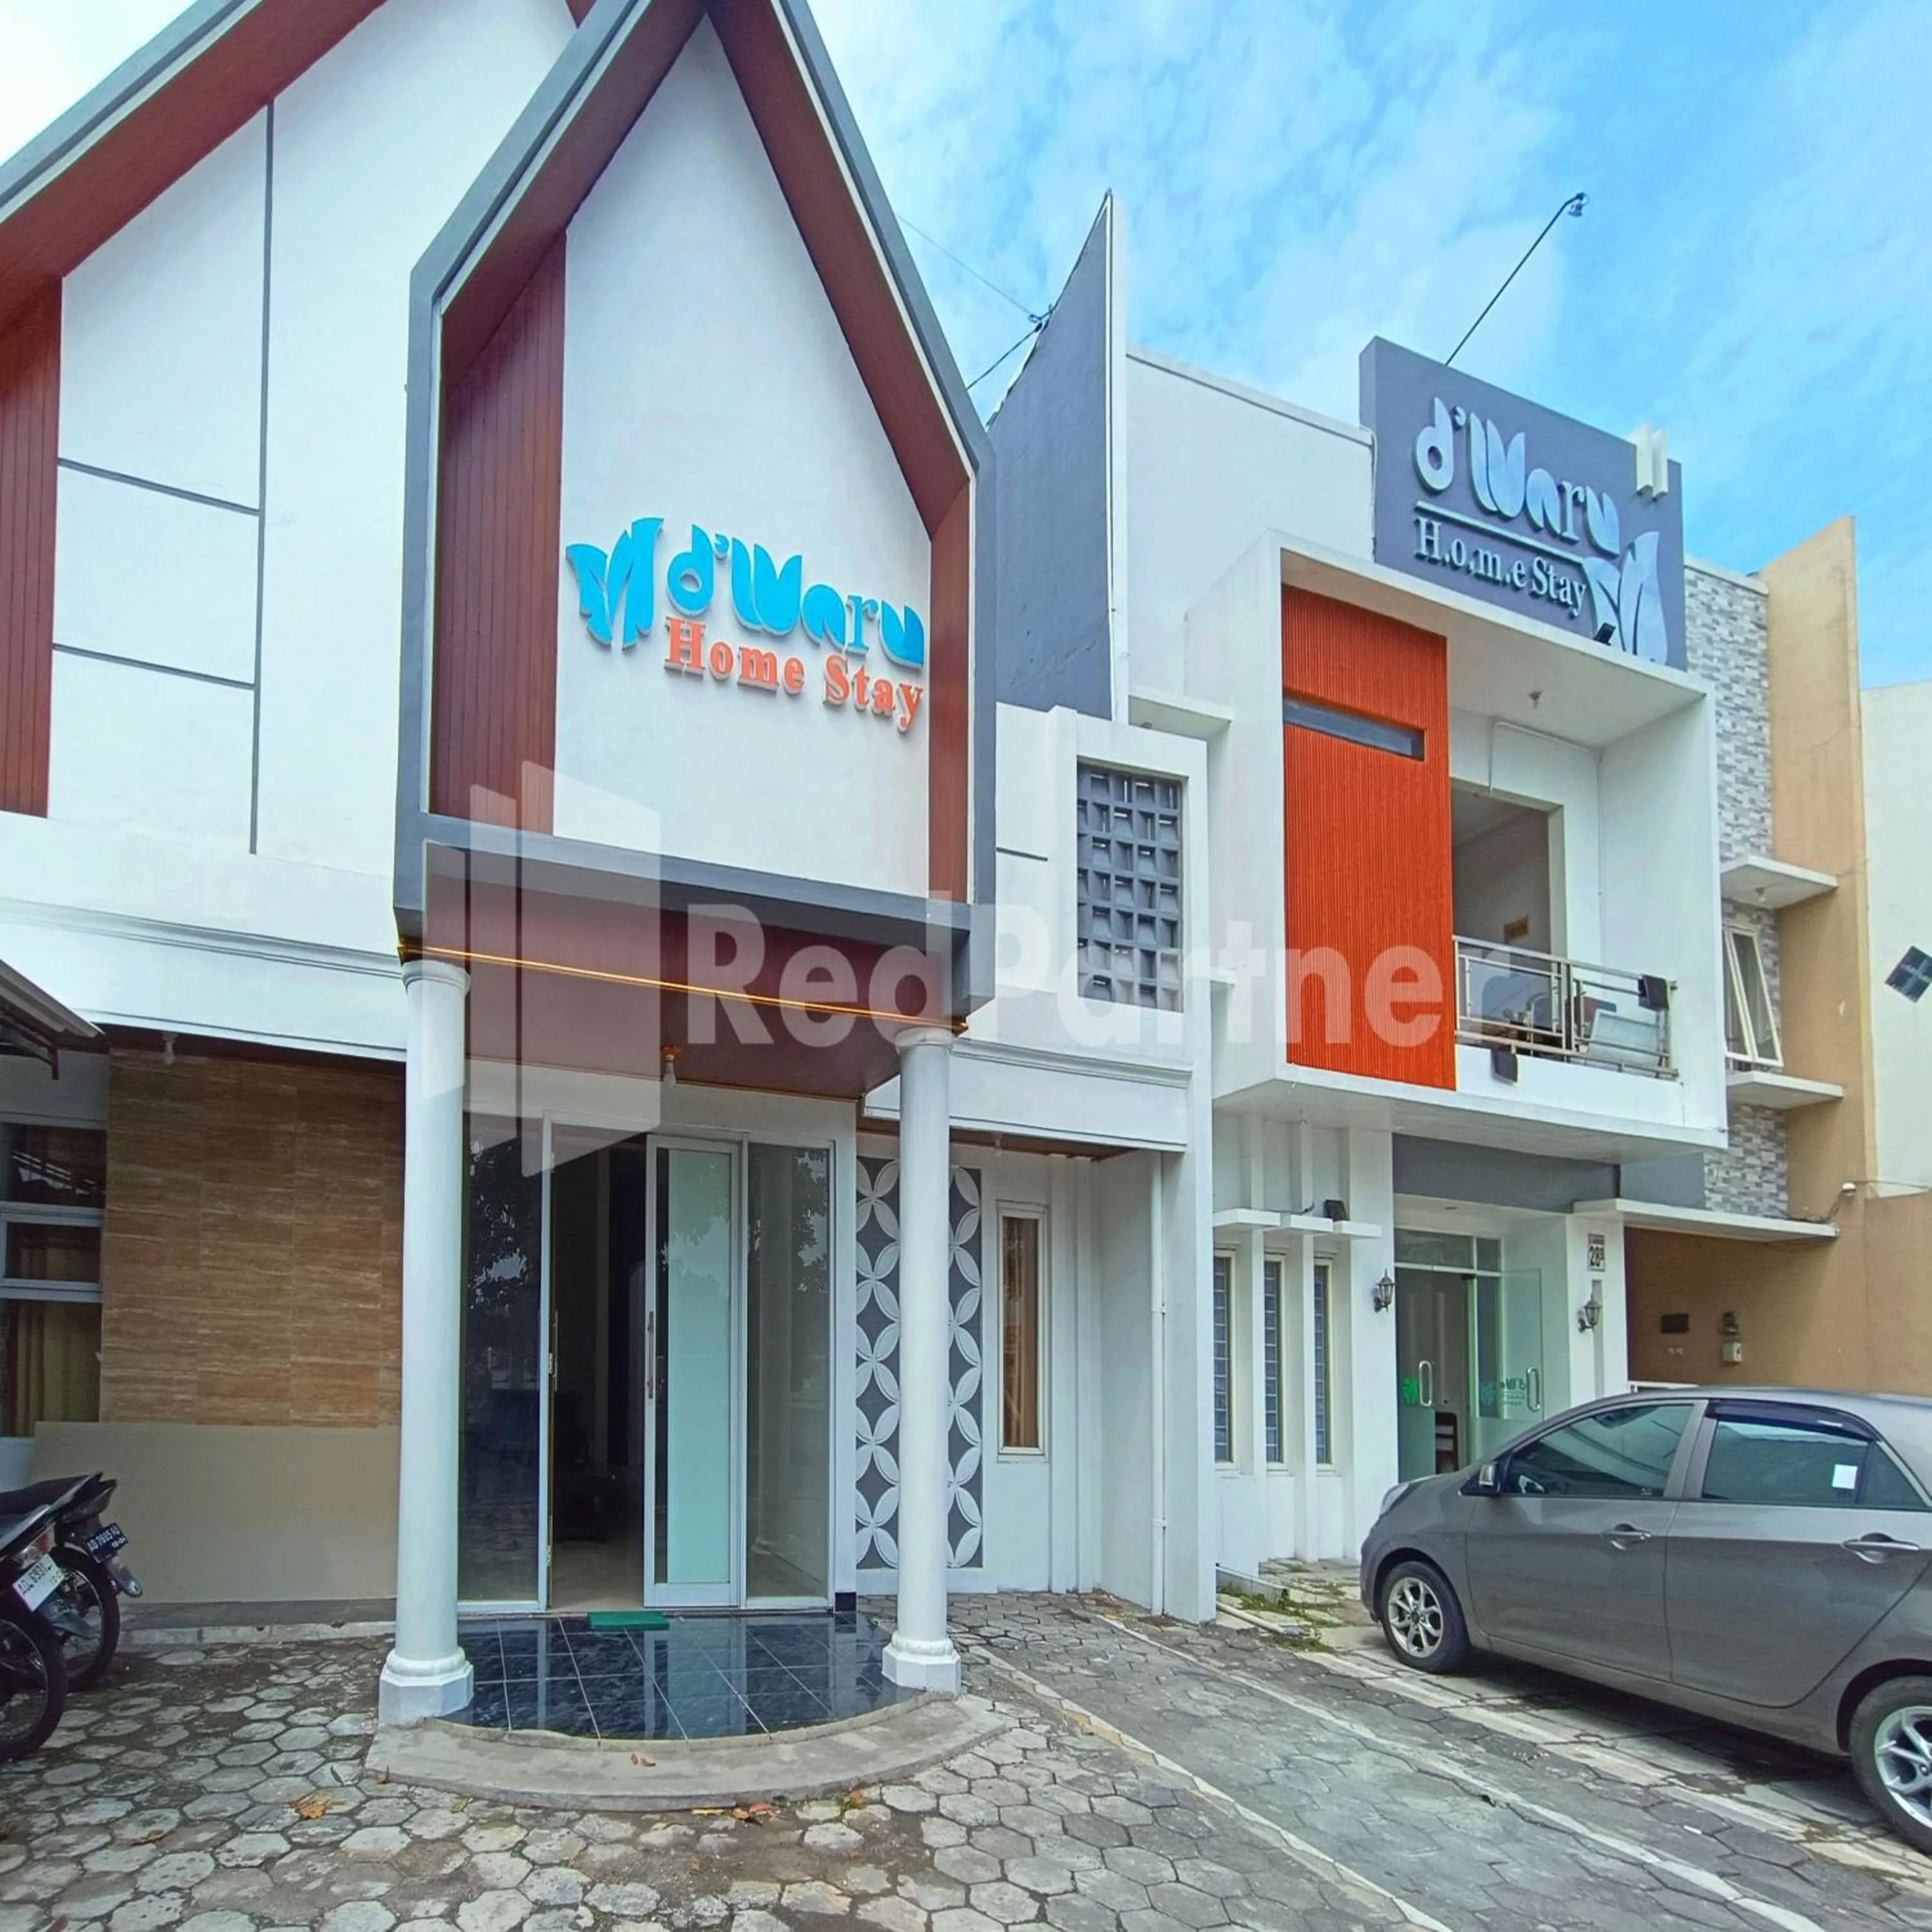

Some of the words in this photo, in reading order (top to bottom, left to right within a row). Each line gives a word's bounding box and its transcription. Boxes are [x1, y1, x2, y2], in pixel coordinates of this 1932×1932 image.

[1530, 556, 1586, 618] Stay
[665, 616, 805, 694] Home
[824, 654, 925, 732] Stay
